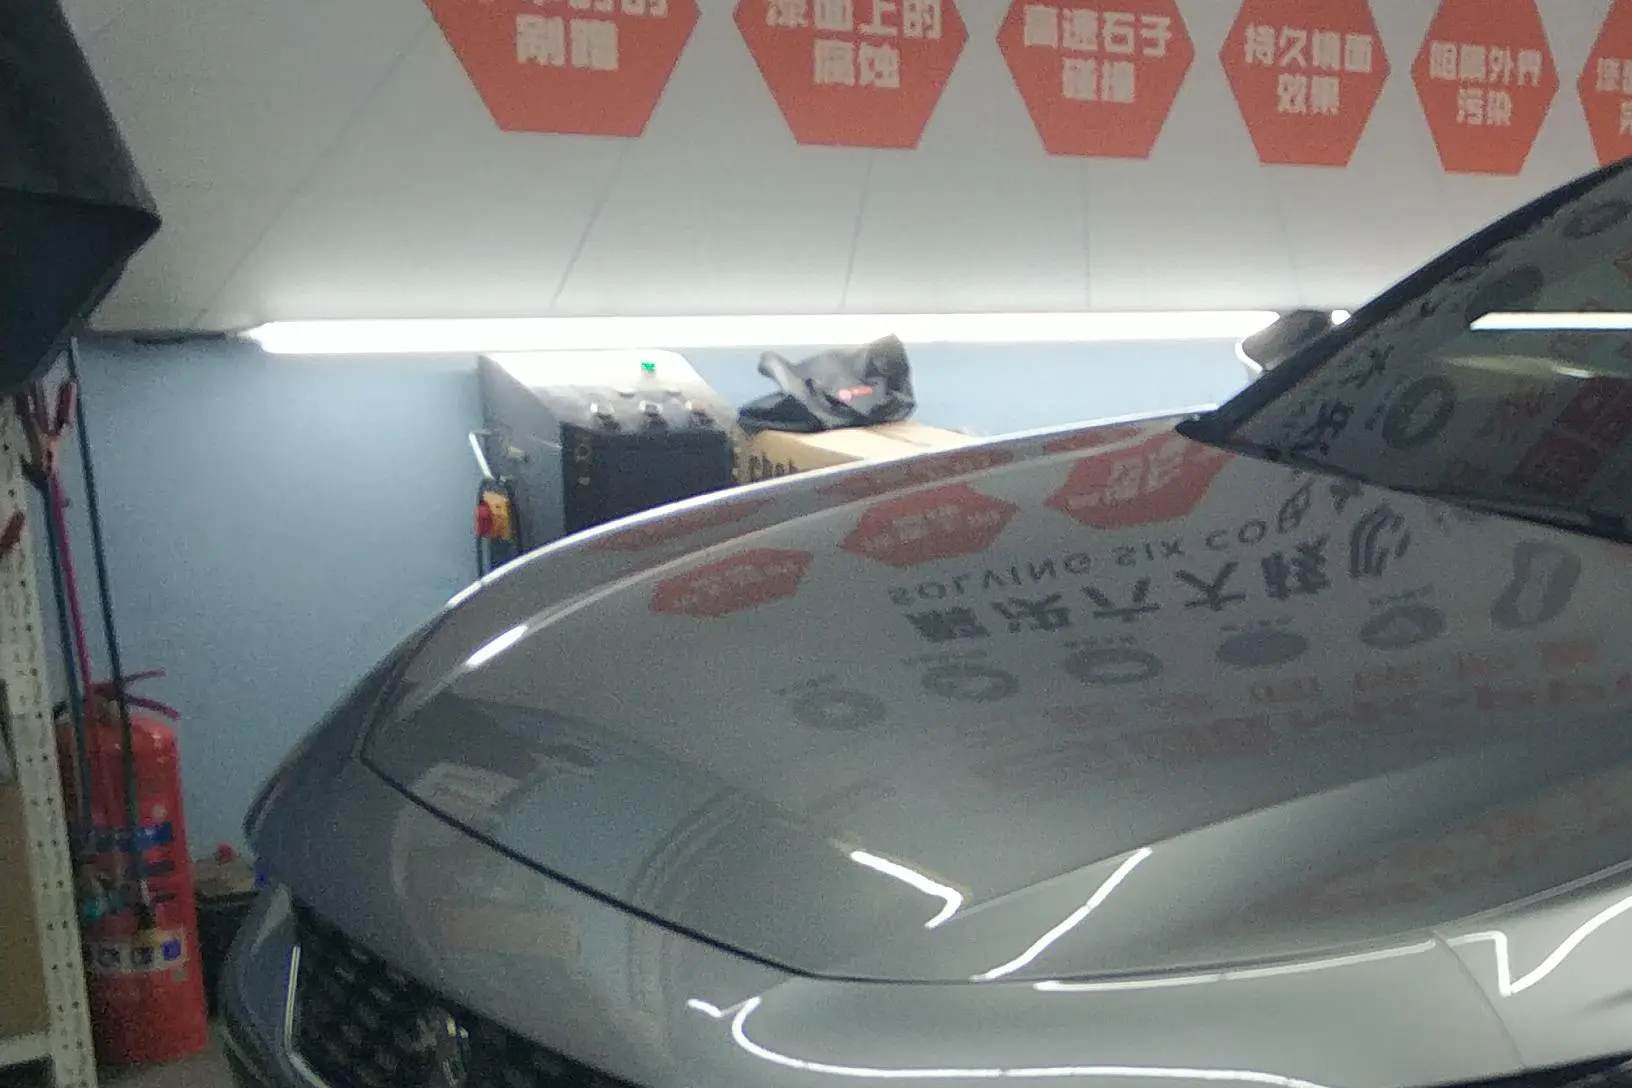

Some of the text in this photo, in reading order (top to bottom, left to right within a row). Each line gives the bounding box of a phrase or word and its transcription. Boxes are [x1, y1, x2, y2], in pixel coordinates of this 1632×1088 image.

[1023, 4, 1173, 58] 高速石子
[1243, 23, 1373, 73] 持久镜面
[1061, 56, 1136, 104] 碰撞
[1277, 73, 1341, 115] 效果
[1456, 89, 1512, 126] 污染
